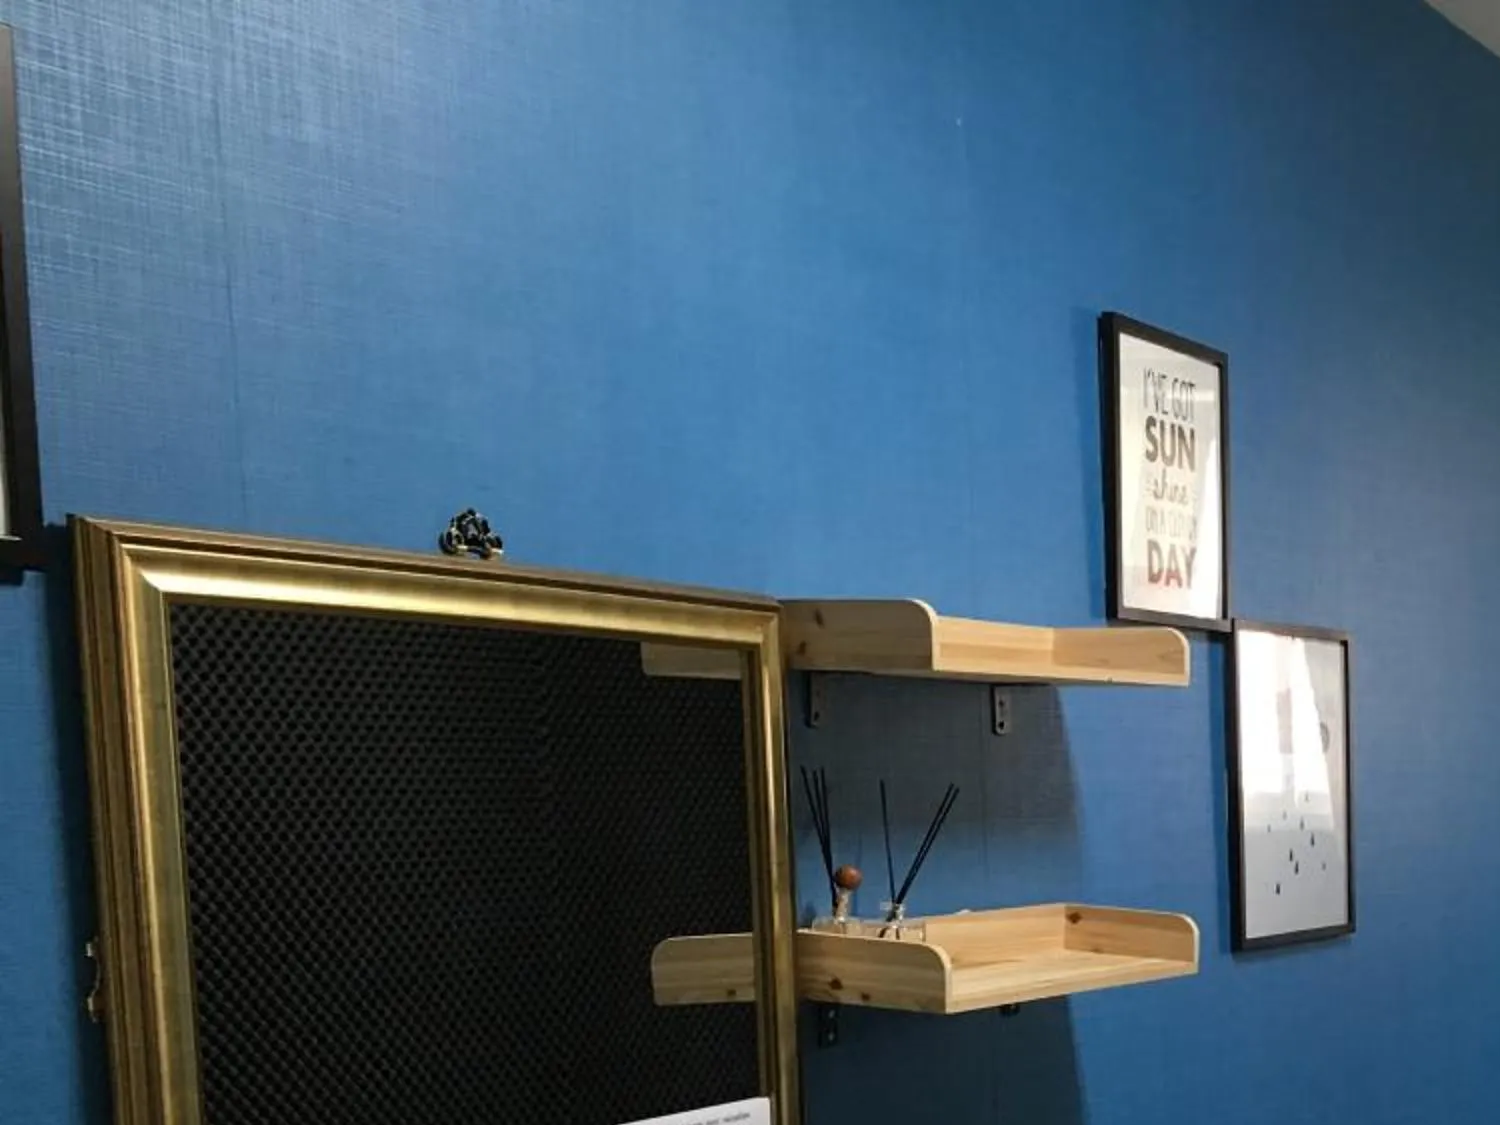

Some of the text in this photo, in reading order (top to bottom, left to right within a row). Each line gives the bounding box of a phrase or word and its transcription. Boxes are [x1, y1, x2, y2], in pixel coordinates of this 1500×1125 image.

[1171, 377, 1196, 422] GOT
[1144, 415, 1196, 472] SUN
[1147, 538, 1198, 590] DAY
